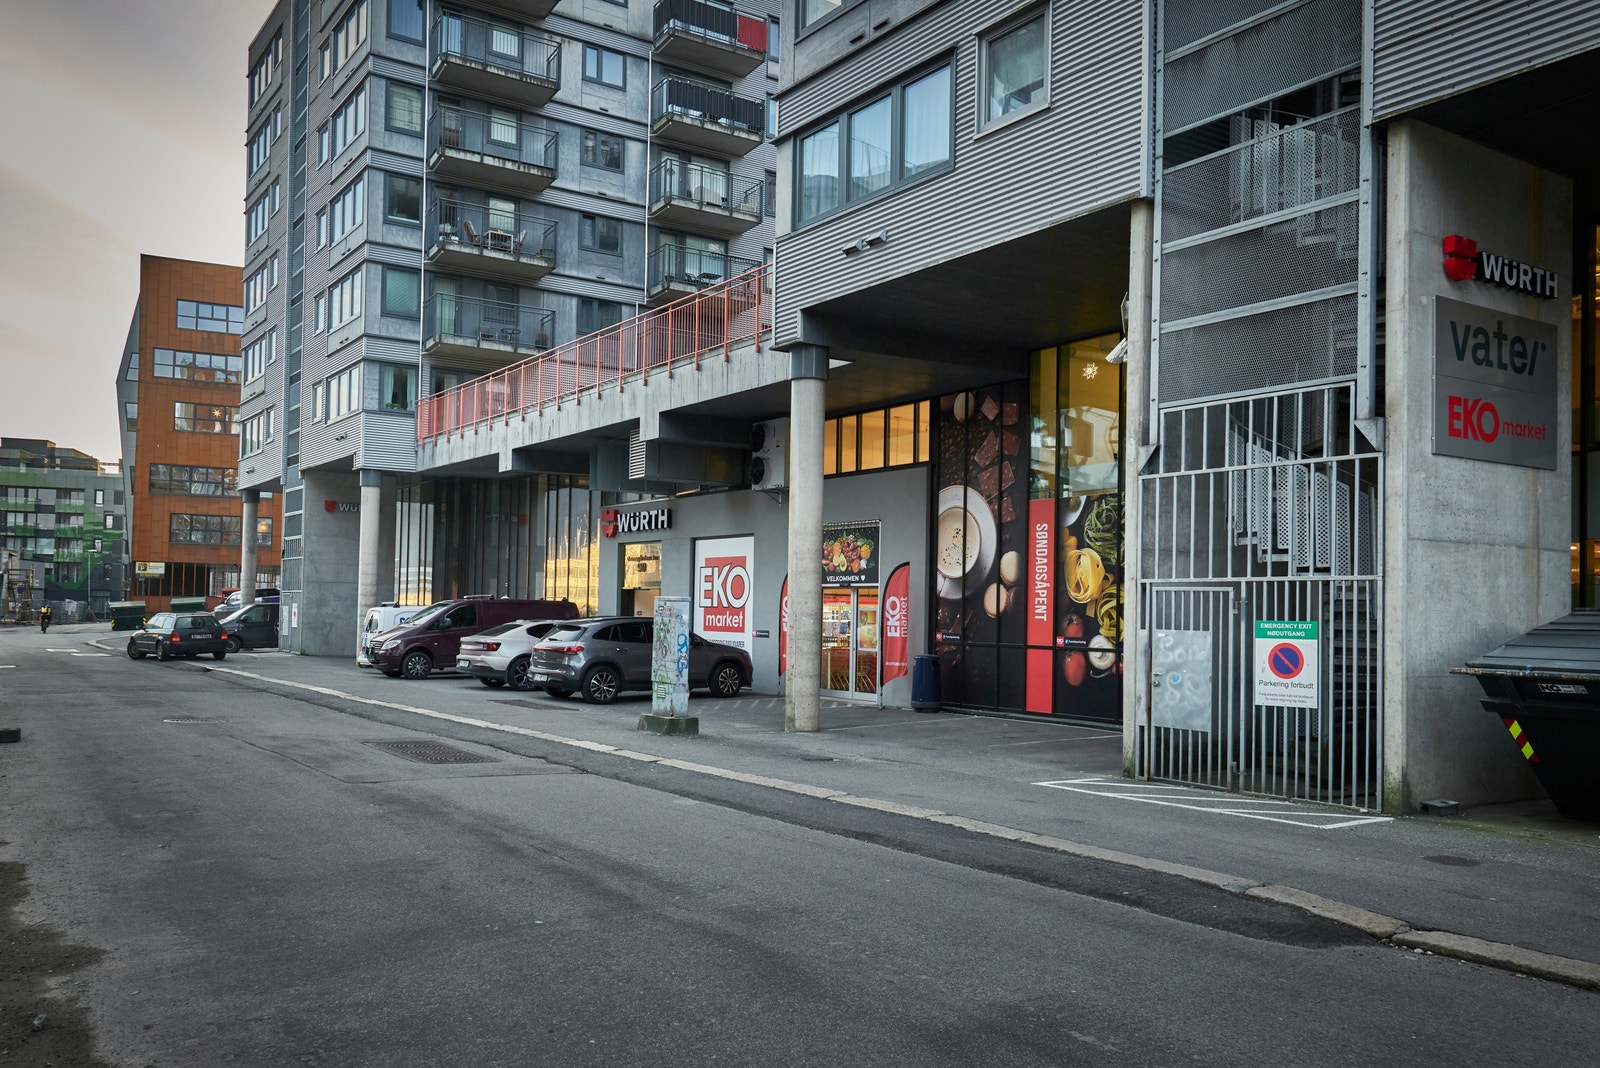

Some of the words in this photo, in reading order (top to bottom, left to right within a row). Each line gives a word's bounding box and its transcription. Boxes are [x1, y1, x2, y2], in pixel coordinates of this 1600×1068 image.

[1482, 251, 1559, 299] WÜRTH
[1448, 395, 1500, 444] EKO
[1502, 420, 1546, 441] market
[617, 509, 668, 533] WÜRTH
[699, 562, 751, 609] EKO
[1034, 523, 1050, 622] SØNDAGSÅPENT
[705, 611, 744, 627] market
[885, 595, 900, 638] EKO
[900, 596, 908, 638] market
[1258, 680, 1289, 689] Parkering
[1290, 681, 1314, 689] forbudt
